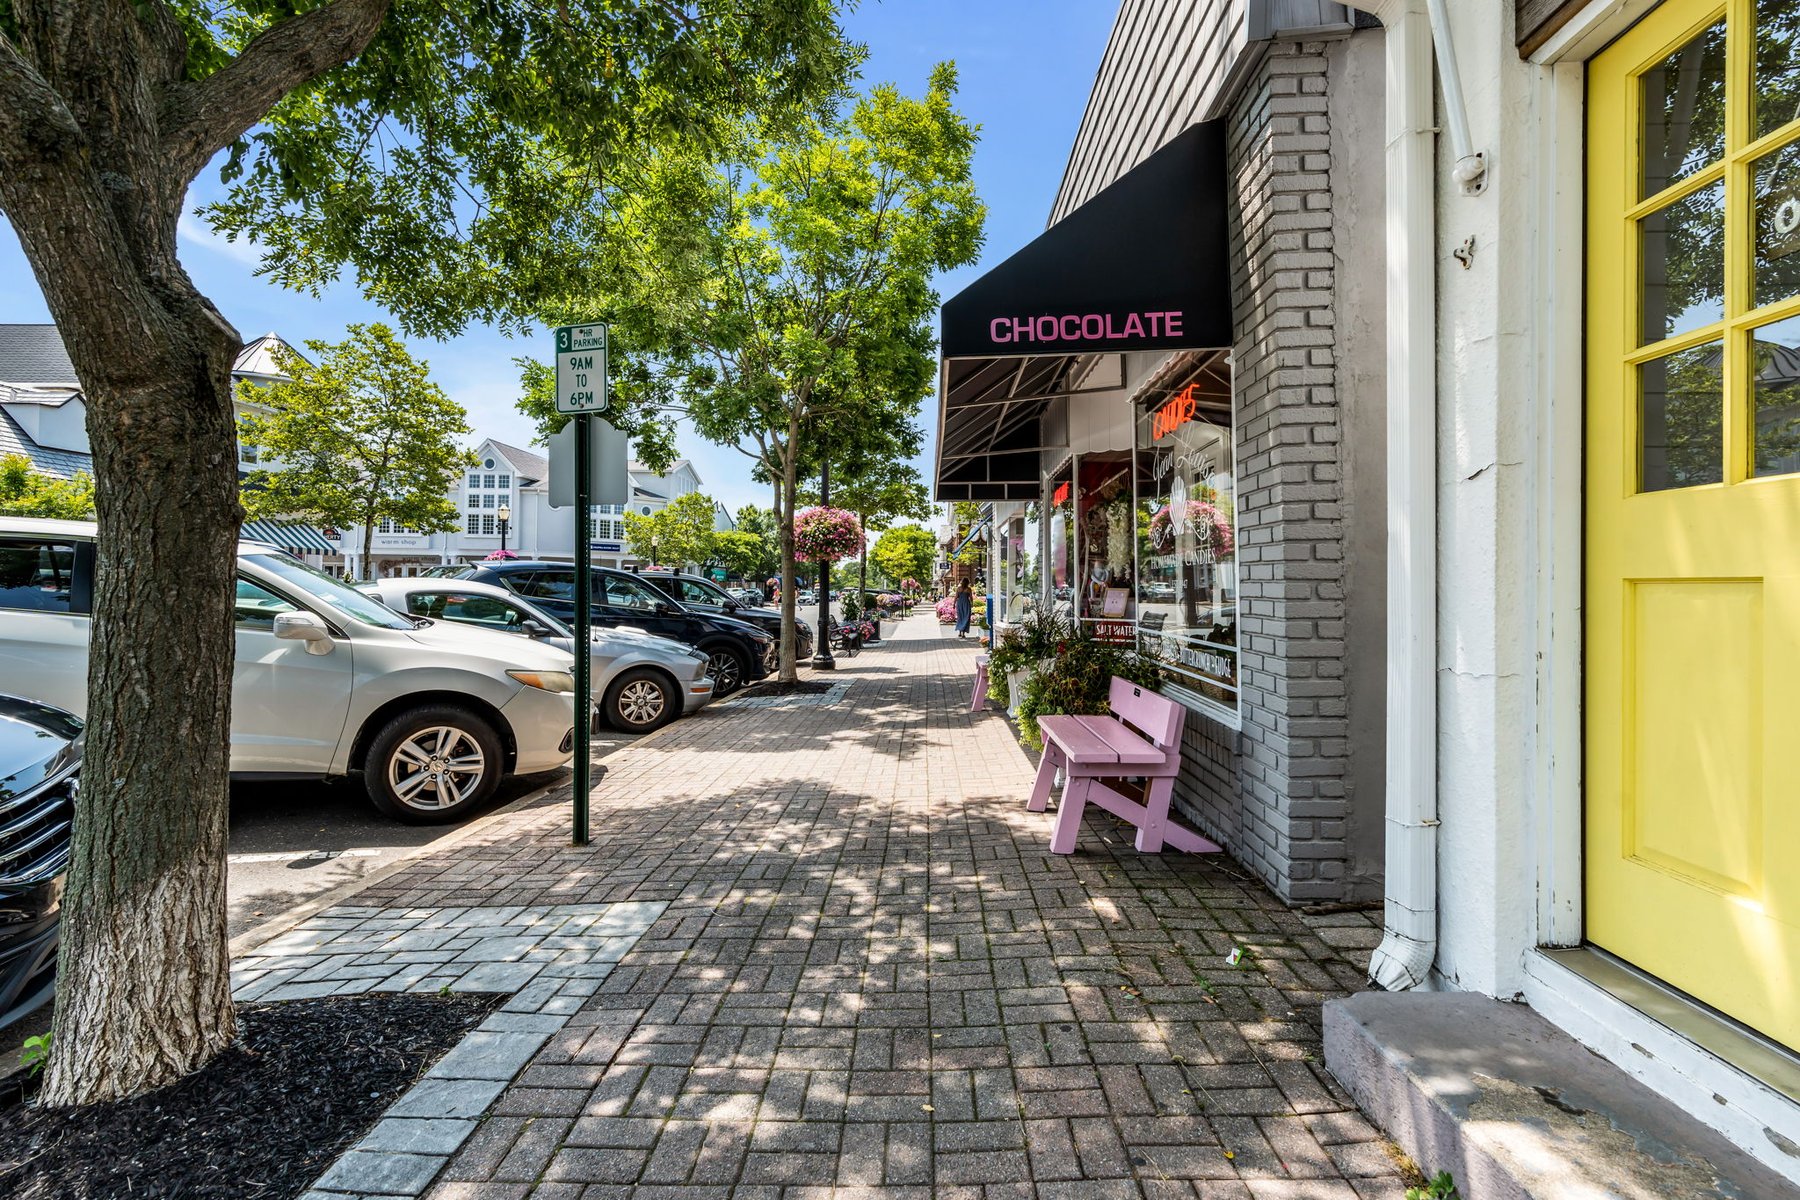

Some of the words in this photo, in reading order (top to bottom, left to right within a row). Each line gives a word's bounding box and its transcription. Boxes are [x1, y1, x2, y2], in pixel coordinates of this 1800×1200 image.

[583, 328, 593, 337] HR
[990, 311, 1184, 343] CHOCOLATE
[560, 332, 568, 348] 3
[573, 337, 603, 348] PARKING
[570, 356, 593, 370] 9AM
[576, 374, 587, 387] TO
[570, 391, 593, 405] 6PM
[1096, 624, 1112, 636] SALT
